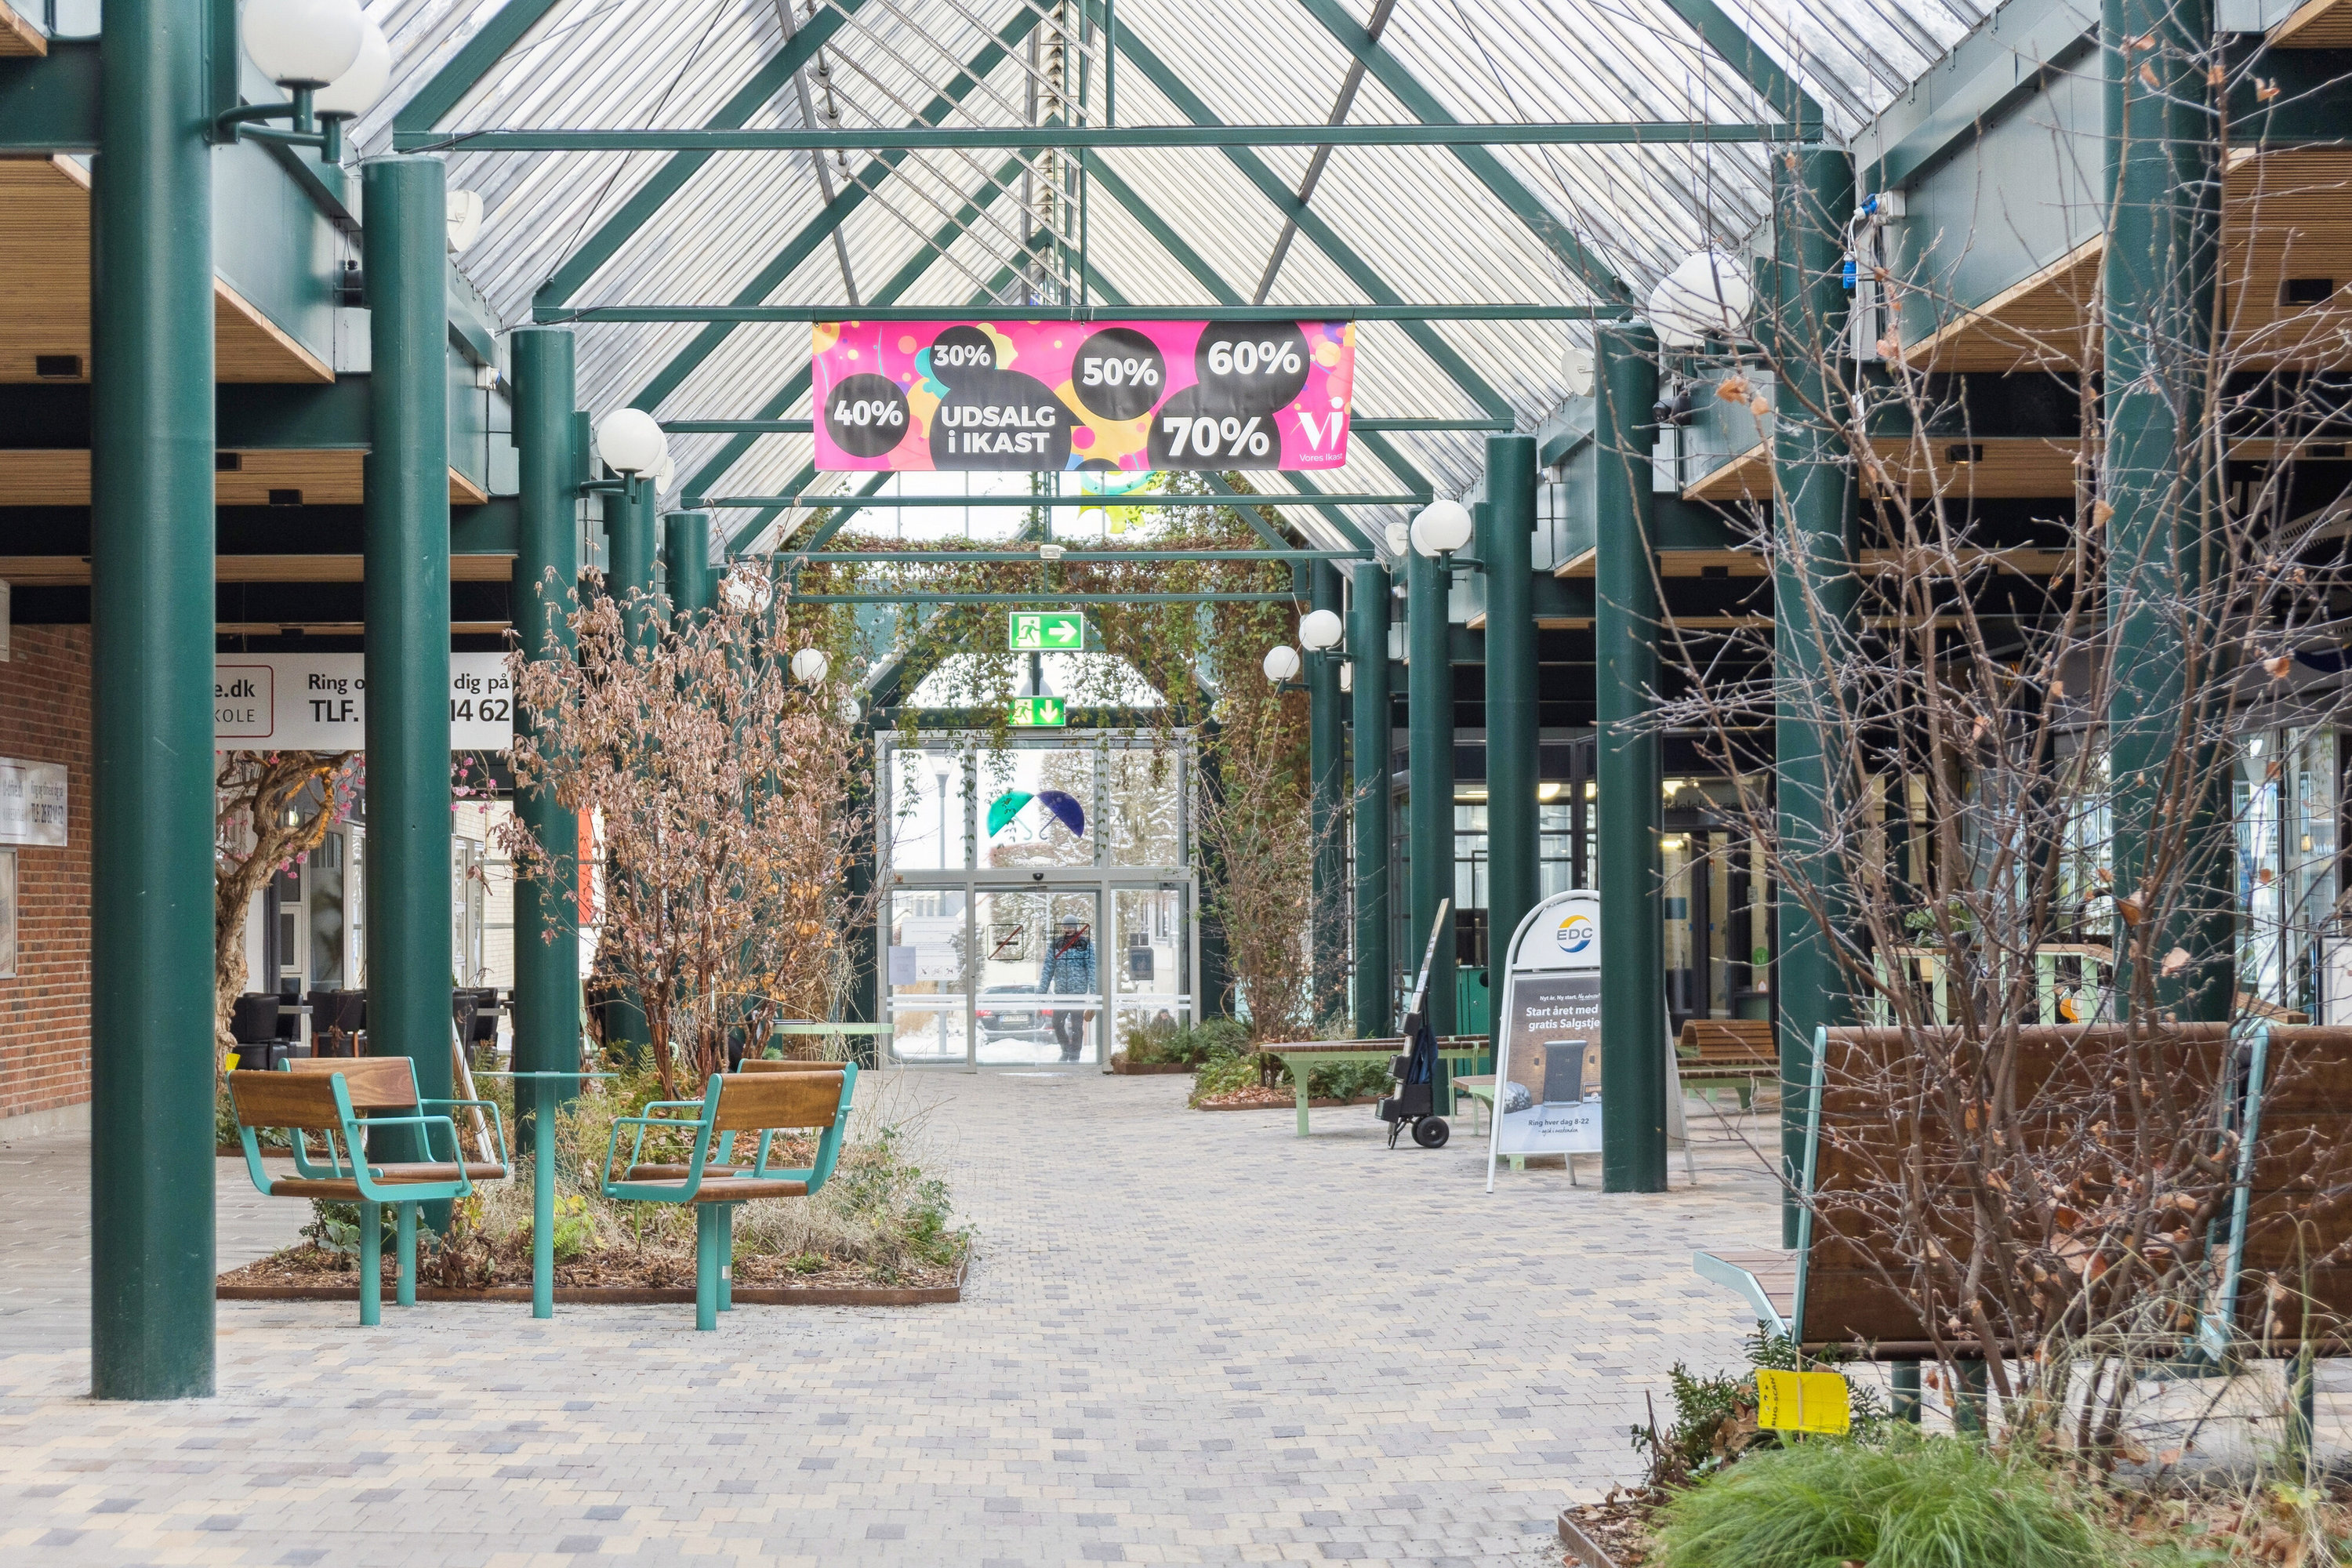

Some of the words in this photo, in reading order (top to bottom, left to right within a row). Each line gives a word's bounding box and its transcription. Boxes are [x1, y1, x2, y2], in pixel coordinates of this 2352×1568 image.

[933, 344, 991, 366] 30%
[1207, 341, 1301, 375] 60%
[1082, 357, 1159, 386] 50%
[833, 400, 903, 426] 40%
[941, 405, 1055, 427] UDSALG
[948, 429, 956, 453] i
[963, 432, 1050, 453] IKAST
[1163, 416, 1269, 456] 70%
[1299, 453, 1323, 462] Vores
[1325, 452, 1343, 461] Ikast
[309, 673, 347, 695] Ring
[454, 673, 481, 695] dig
[488, 673, 510, 695] på
[309, 699, 358, 722] TLF.
[479, 698, 510, 721] 62
[1556, 927, 1593, 941] EDC
[1526, 1007, 1551, 1017] Start
[1552, 1005, 1573, 1015] året
[1575, 1004, 1599, 1014] med
[1528, 1018, 1558, 1032] gratis
[1559, 1018, 1600, 1030] Salgstje
